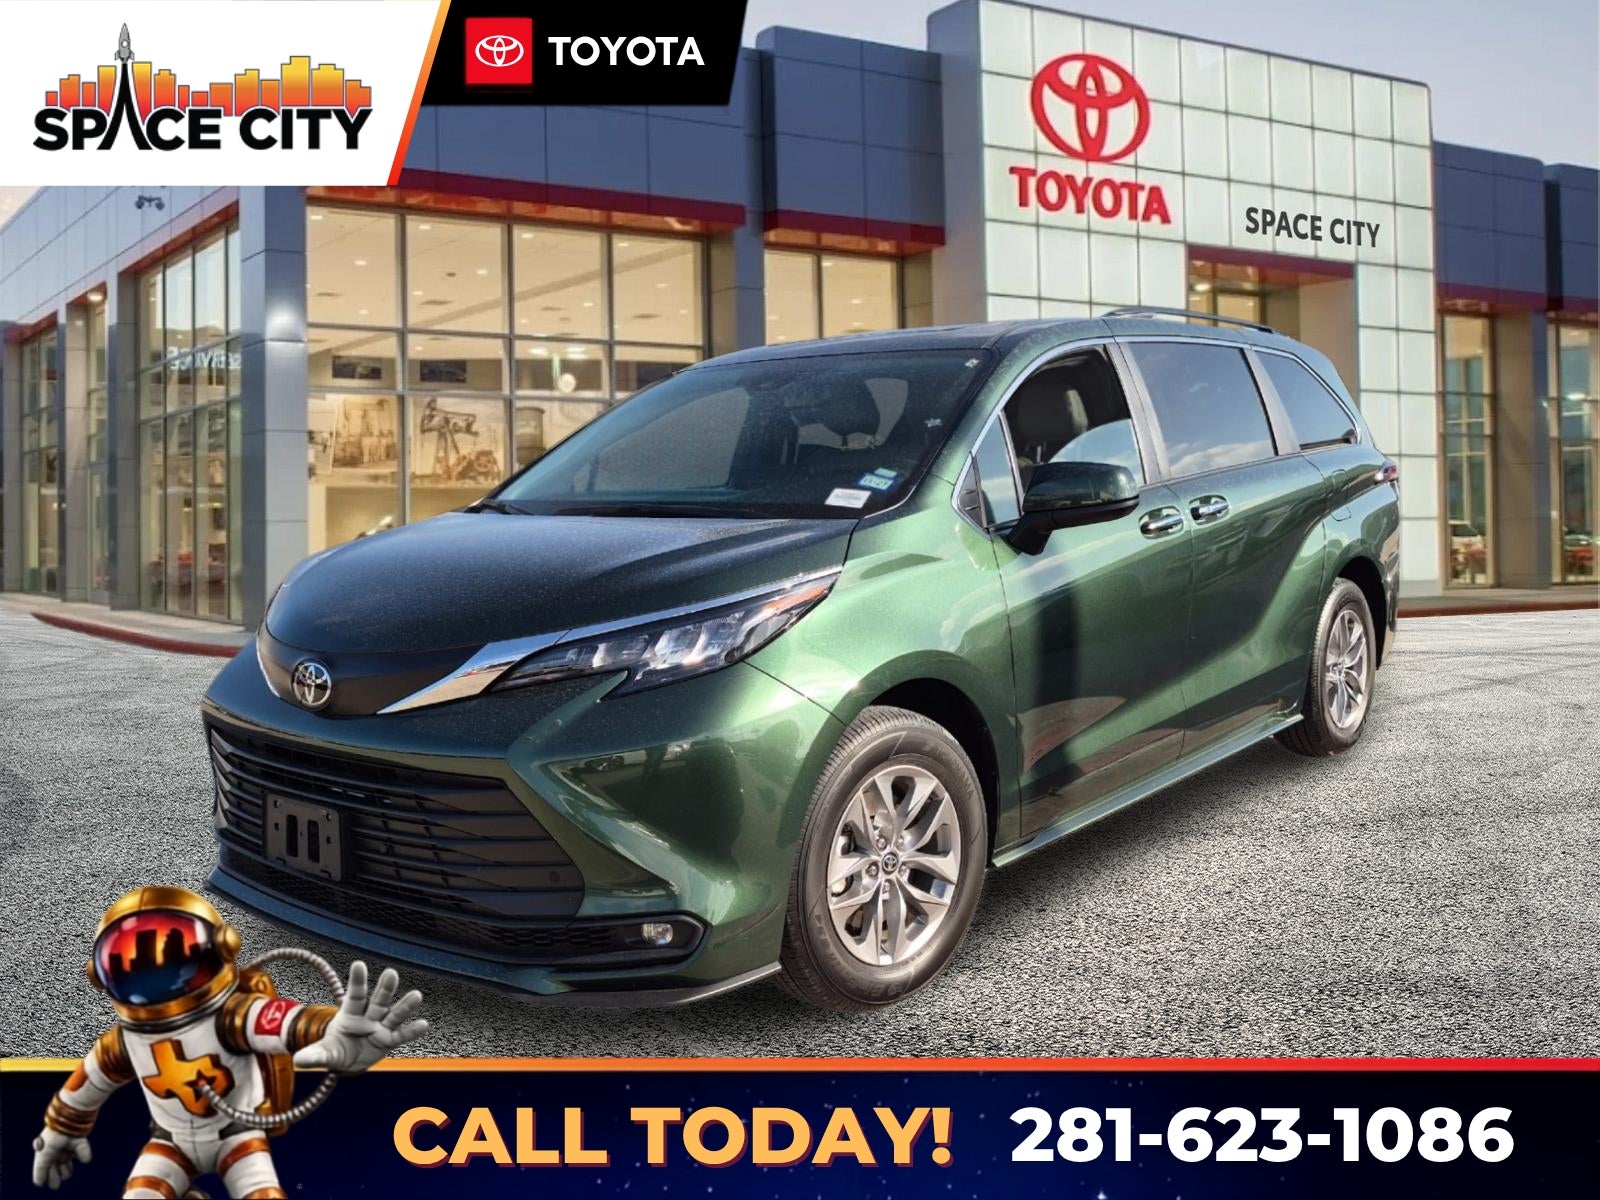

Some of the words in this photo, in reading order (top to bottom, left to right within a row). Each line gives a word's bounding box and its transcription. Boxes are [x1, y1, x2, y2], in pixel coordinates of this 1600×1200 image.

[1009, 167, 1171, 224] TOYOTA
[1245, 207, 1323, 242] SPACE
[1329, 218, 1380, 248] CITY
